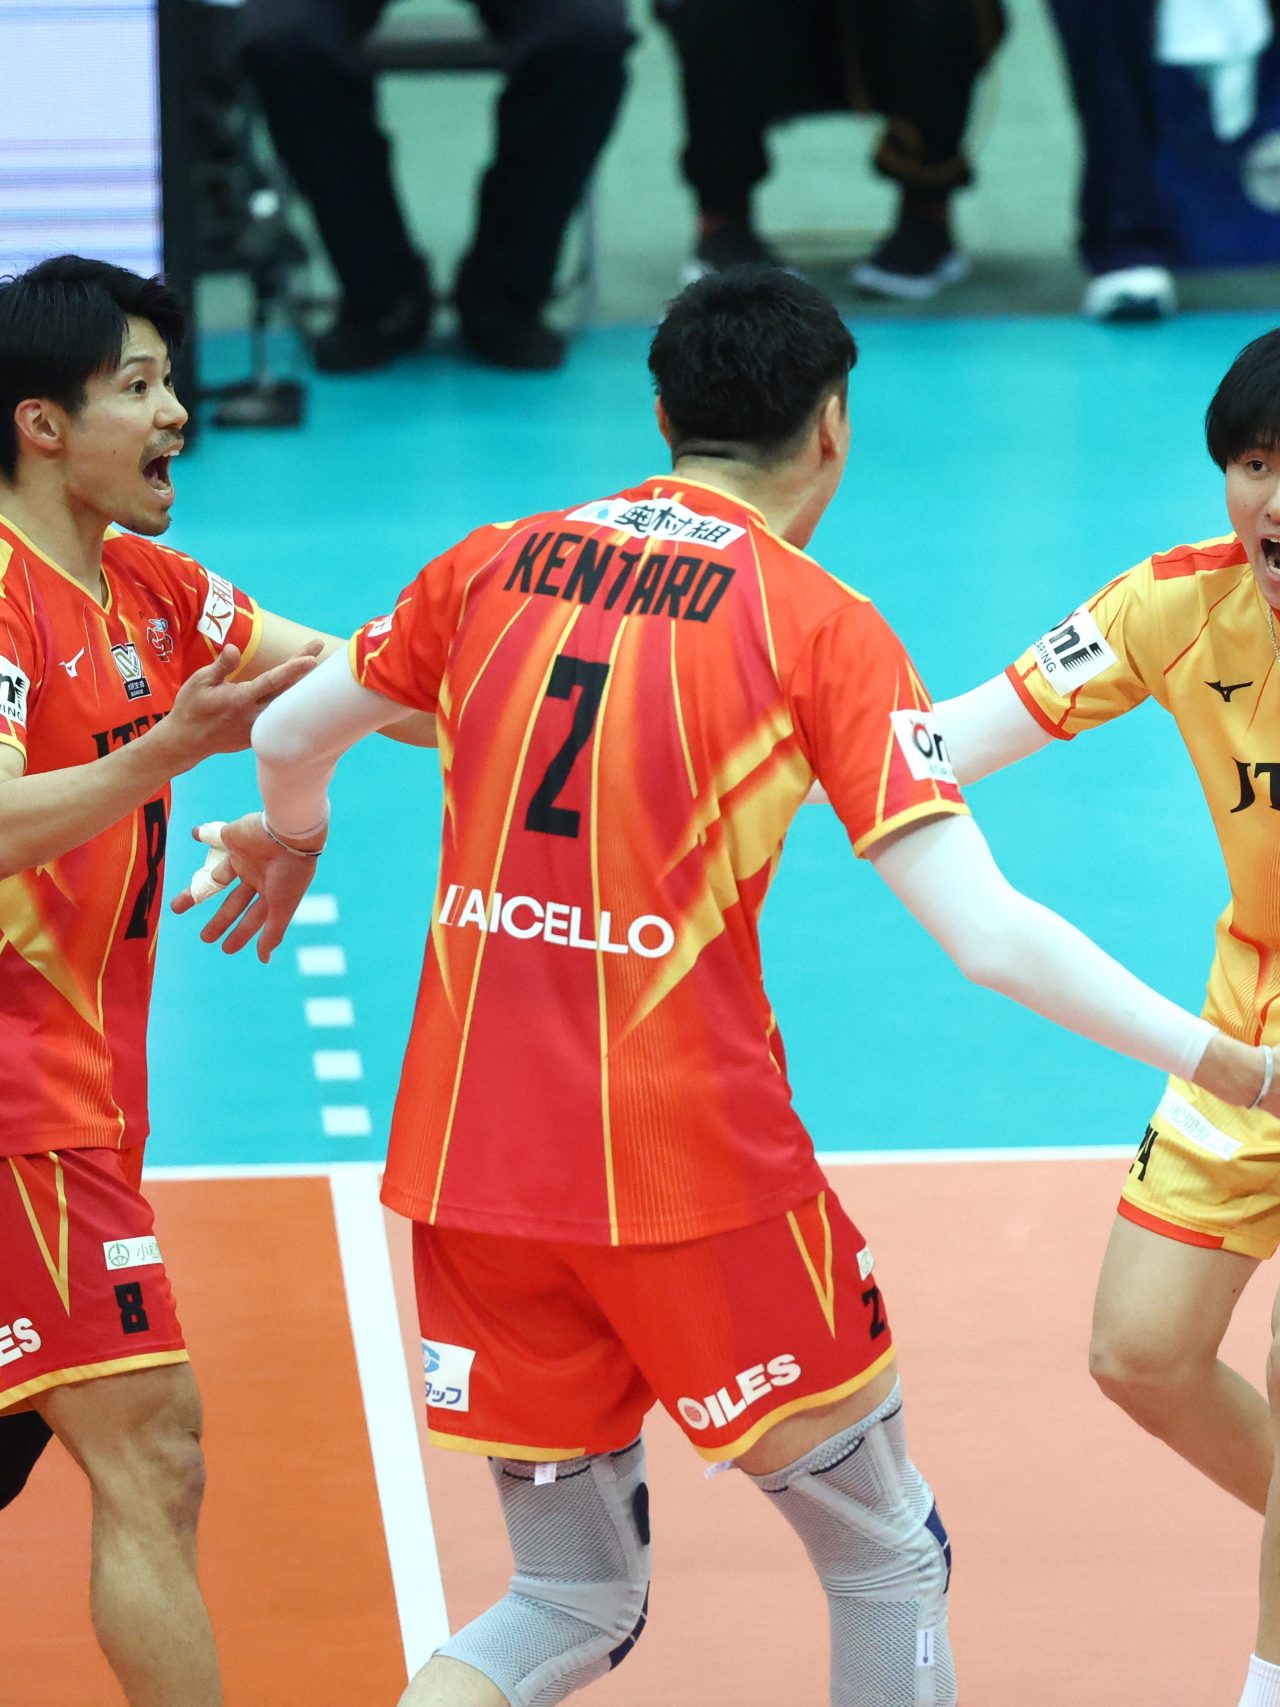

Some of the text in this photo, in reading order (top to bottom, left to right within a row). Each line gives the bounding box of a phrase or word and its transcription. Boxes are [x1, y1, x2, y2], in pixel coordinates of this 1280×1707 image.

[614, 505, 732, 544] 奥村組
[503, 531, 737, 623] KENTARO
[524, 653, 611, 839] 2
[113, 1281, 149, 1335] 8
[677, 1353, 802, 1431] OILES
